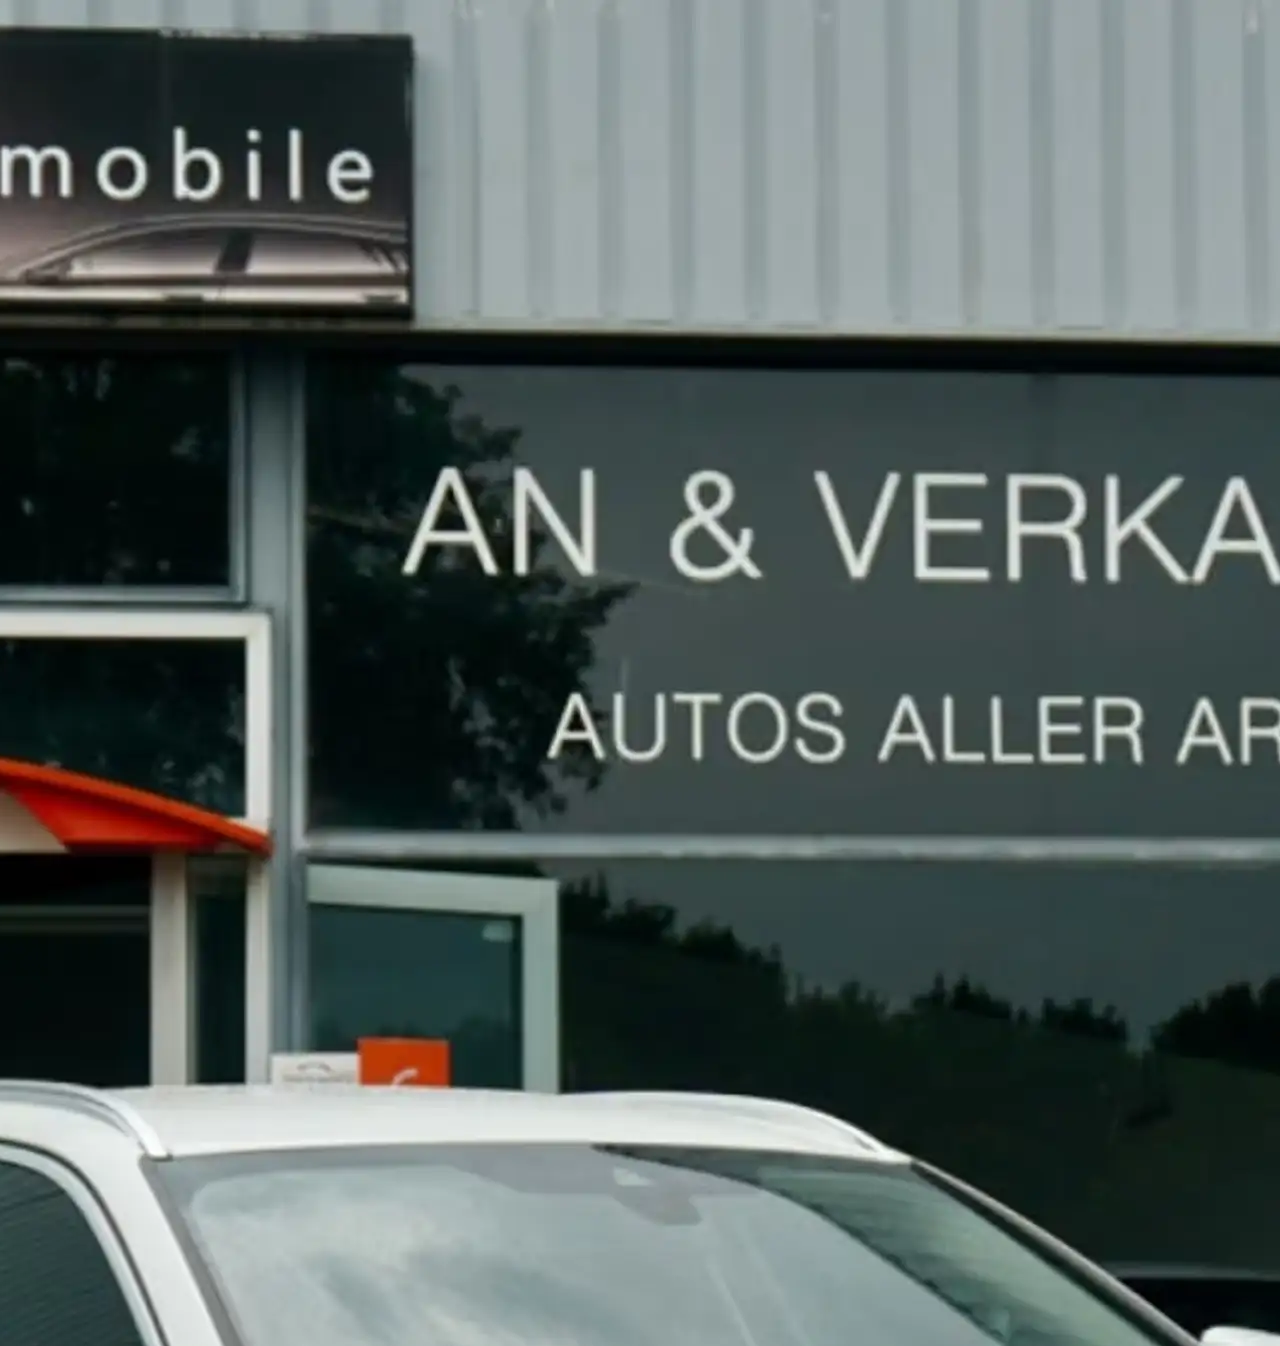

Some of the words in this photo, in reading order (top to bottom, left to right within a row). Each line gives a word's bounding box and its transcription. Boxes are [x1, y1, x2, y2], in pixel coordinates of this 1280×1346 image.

[402, 466, 598, 577] AN
[669, 469, 763, 582] &
[547, 691, 846, 764] AUTOS
[877, 694, 1144, 765] ALLER
